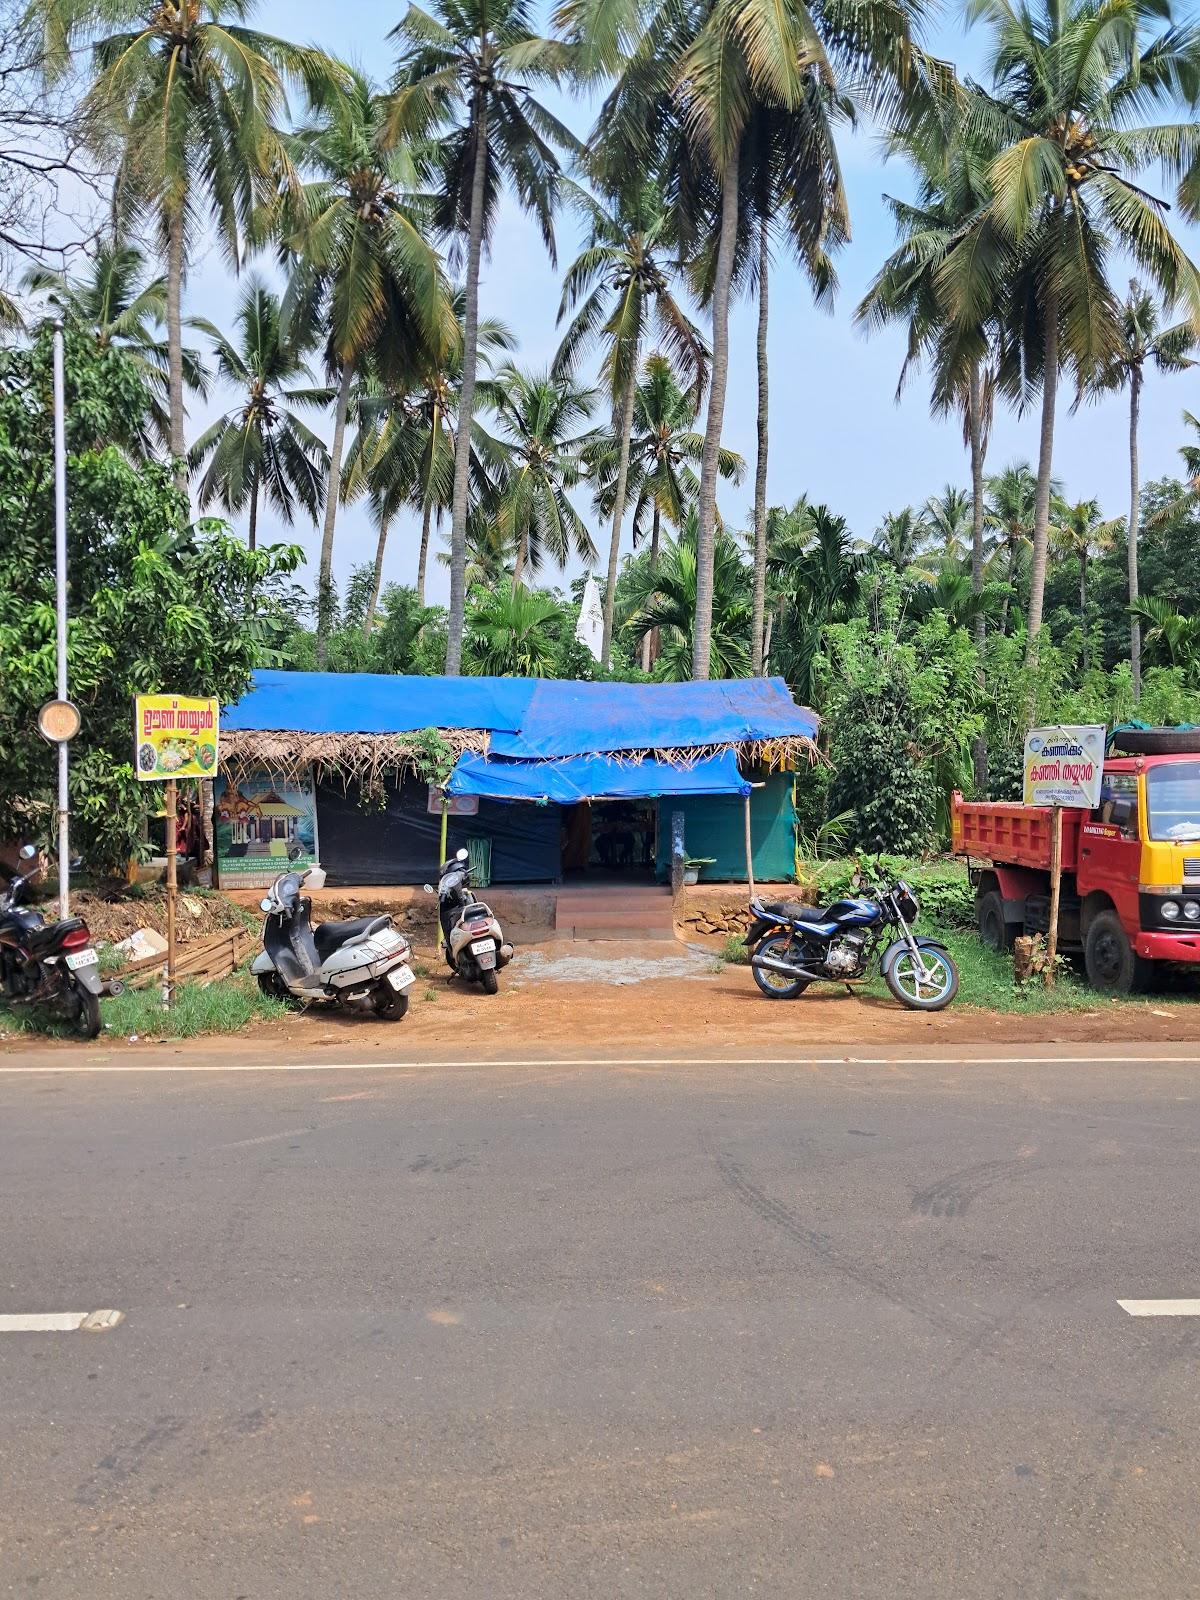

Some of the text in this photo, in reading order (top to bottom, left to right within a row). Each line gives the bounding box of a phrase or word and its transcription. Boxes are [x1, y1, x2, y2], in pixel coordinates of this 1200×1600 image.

[144, 701, 212, 736] ഊണ് തയ്യാർ
[1030, 760, 1093, 785] കഞ്ഞി തയ്യാർ
